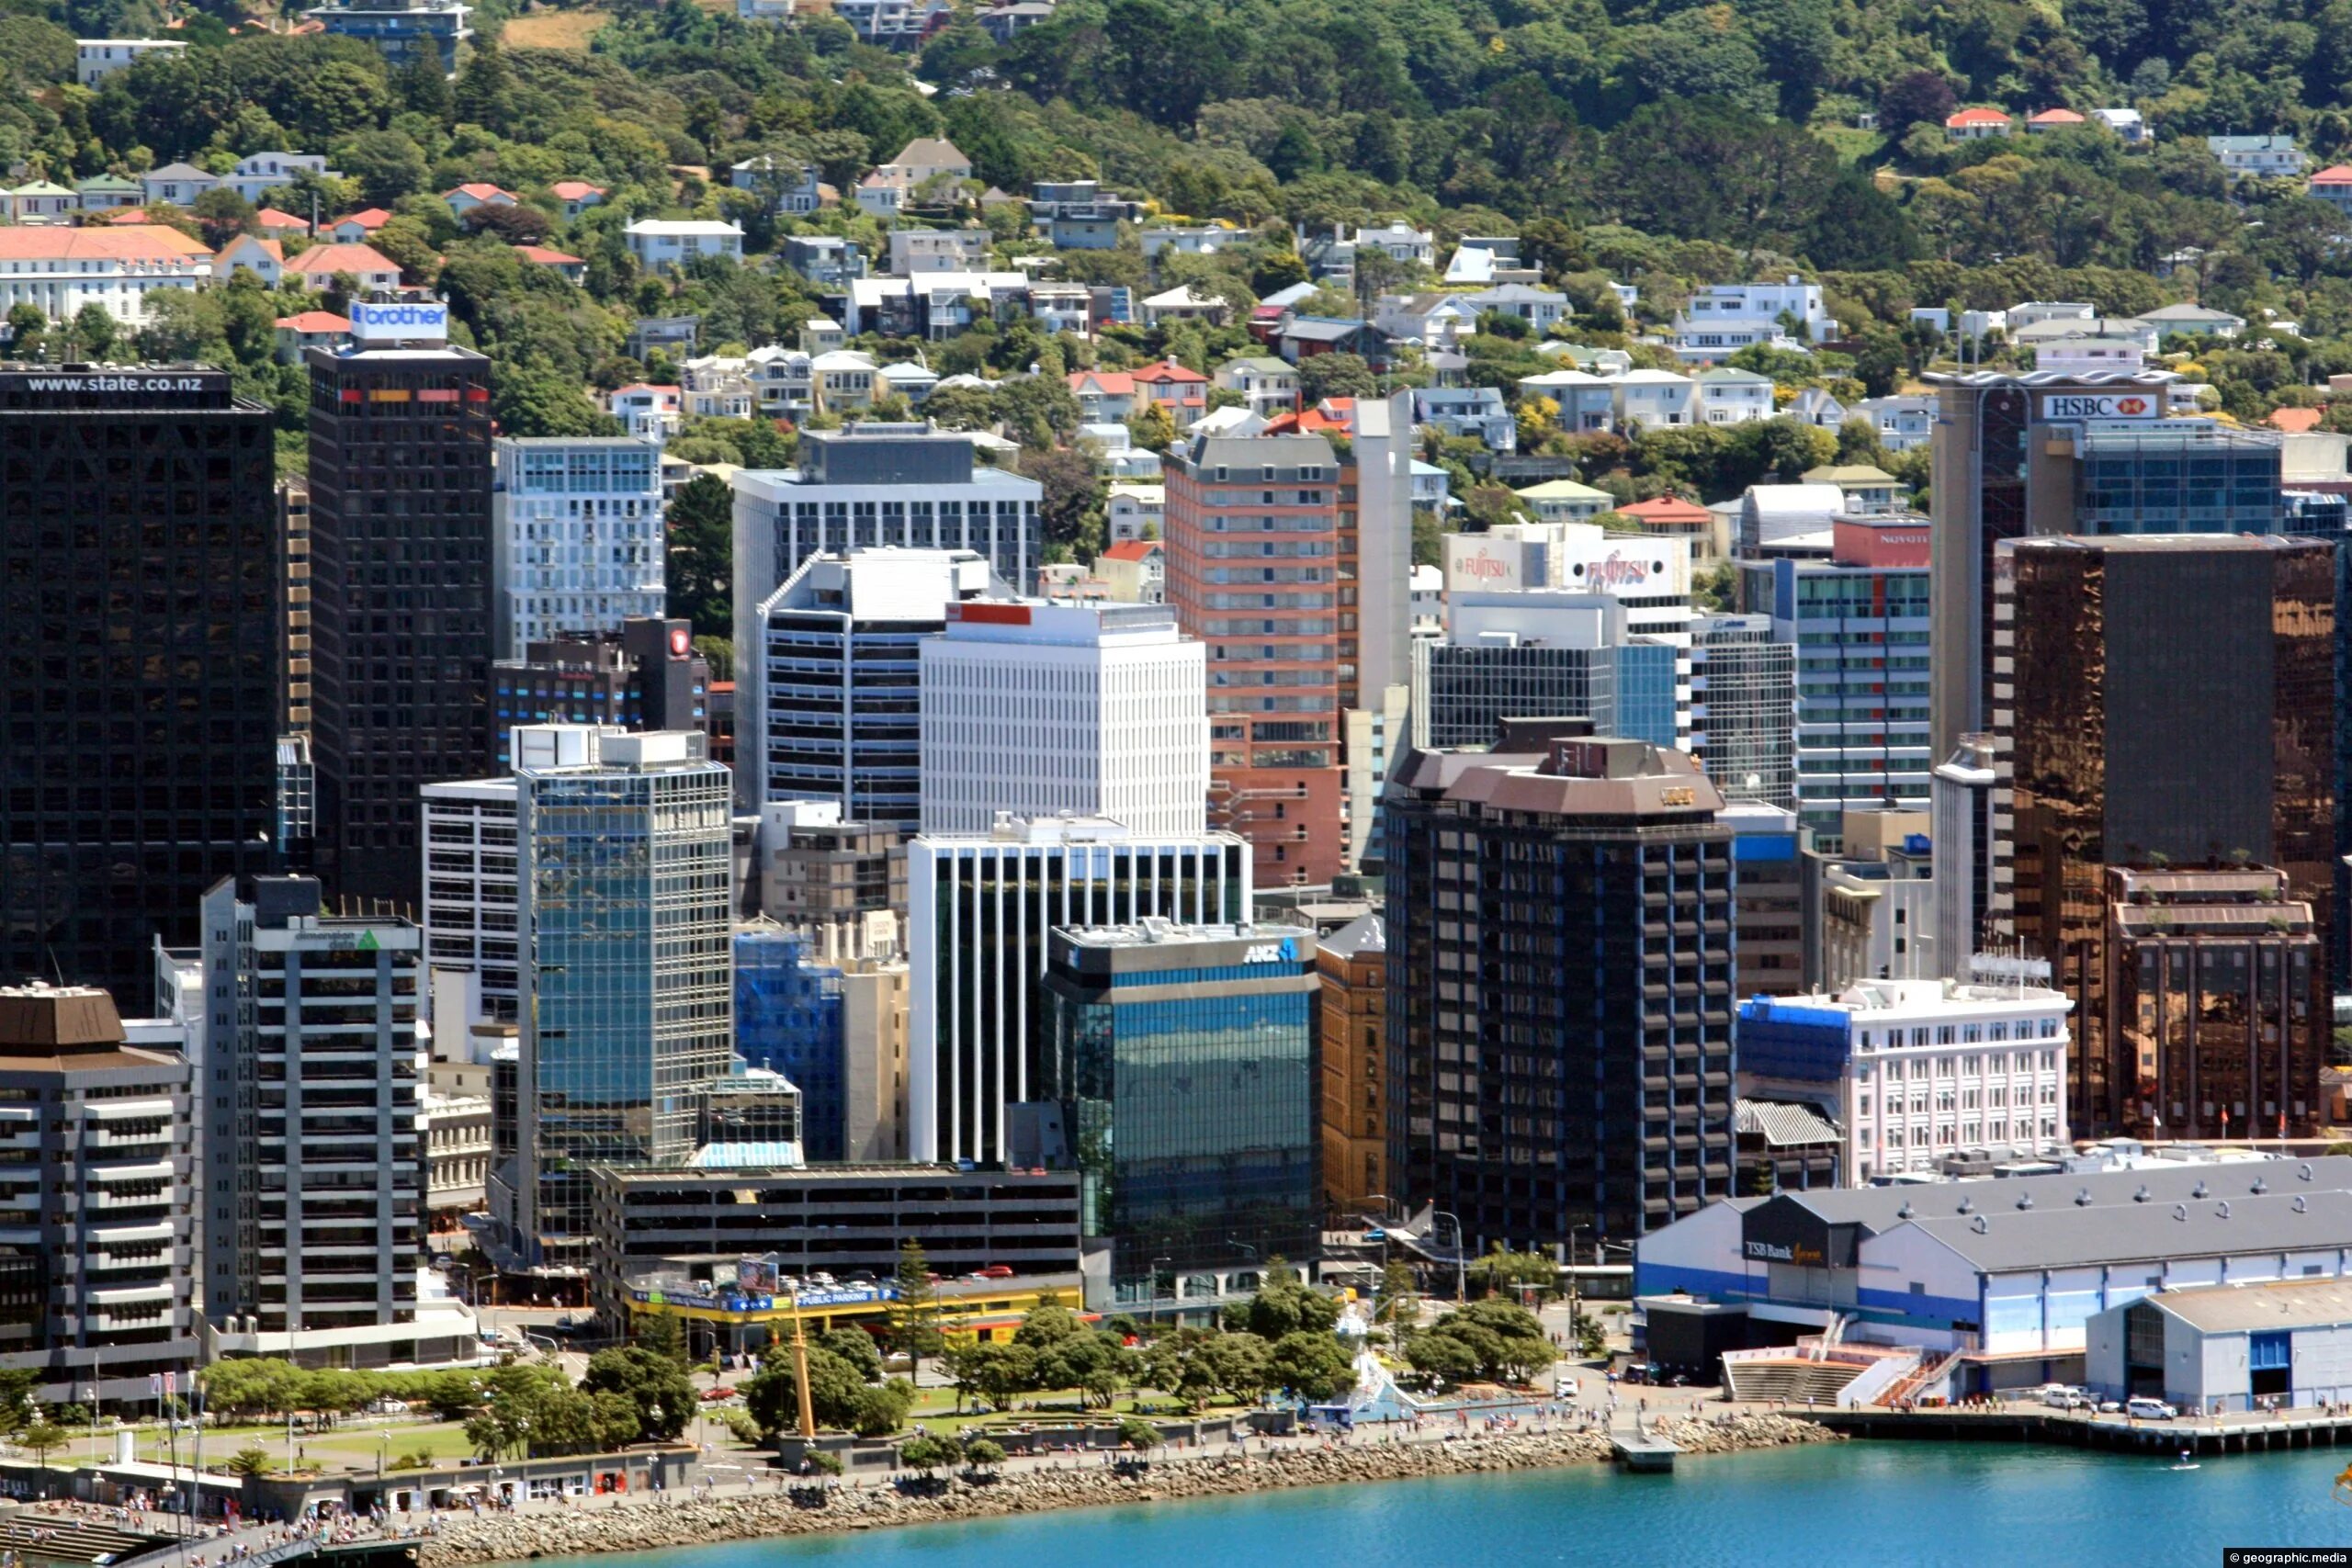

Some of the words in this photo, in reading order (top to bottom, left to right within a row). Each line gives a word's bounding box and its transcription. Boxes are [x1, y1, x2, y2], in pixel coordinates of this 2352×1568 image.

[366, 306, 447, 324] brother
[28, 376, 202, 391] www.state.co.nz
[2052, 398, 2112, 416] HSBC
[1465, 552, 1505, 580] FUJITSU
[1587, 555, 1648, 582] FUJITSU
[1243, 945, 1280, 964] ANZ
[1746, 1241, 1766, 1257] TSB
[1767, 1243, 1793, 1260] Bank
[802, 1294, 831, 1305] PUBLIC
[832, 1292, 868, 1303] PARKING
